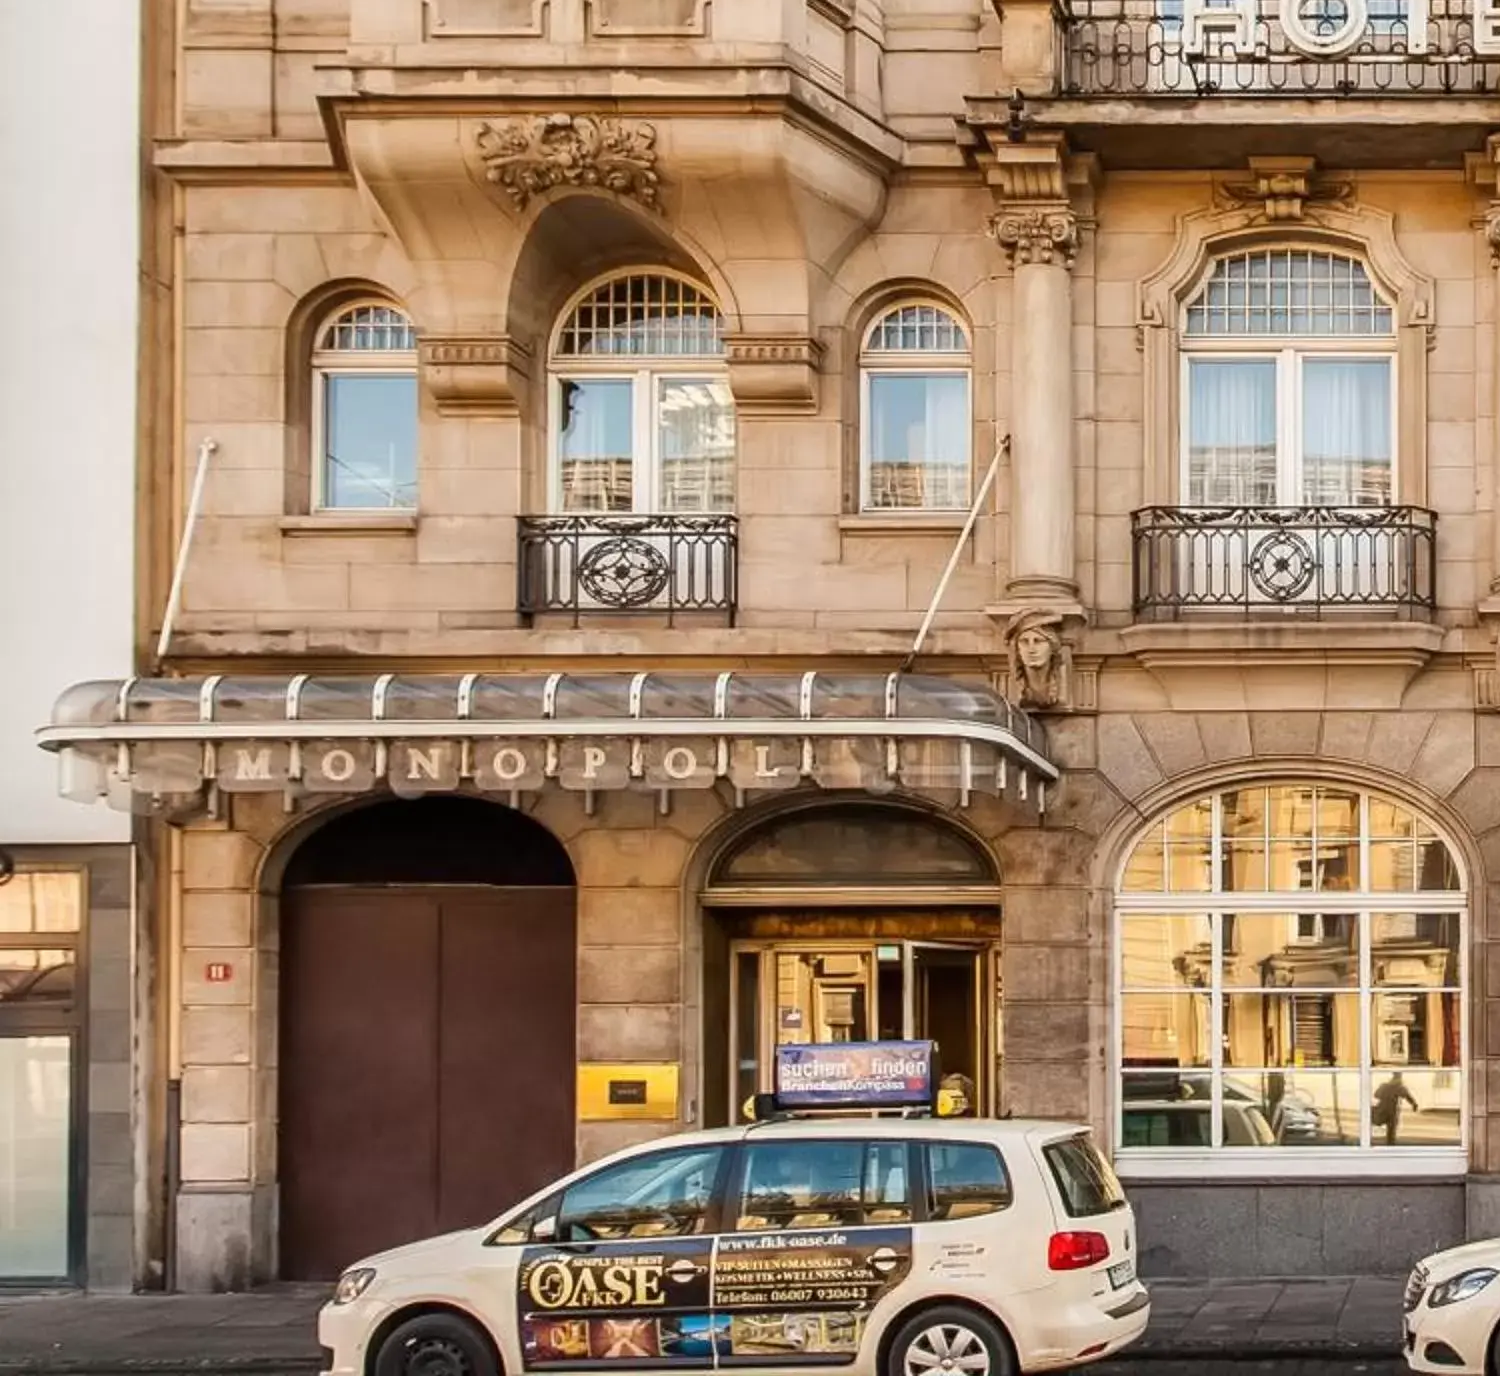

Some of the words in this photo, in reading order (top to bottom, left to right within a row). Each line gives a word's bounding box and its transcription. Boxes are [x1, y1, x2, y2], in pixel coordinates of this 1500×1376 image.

[234, 746, 781, 782] MONOPOL
[780, 1058, 848, 1078] suchen
[871, 1057, 928, 1078] finden
[718, 1232, 848, 1252] www.fkk-oase.de
[529, 1260, 666, 1309] OASE
